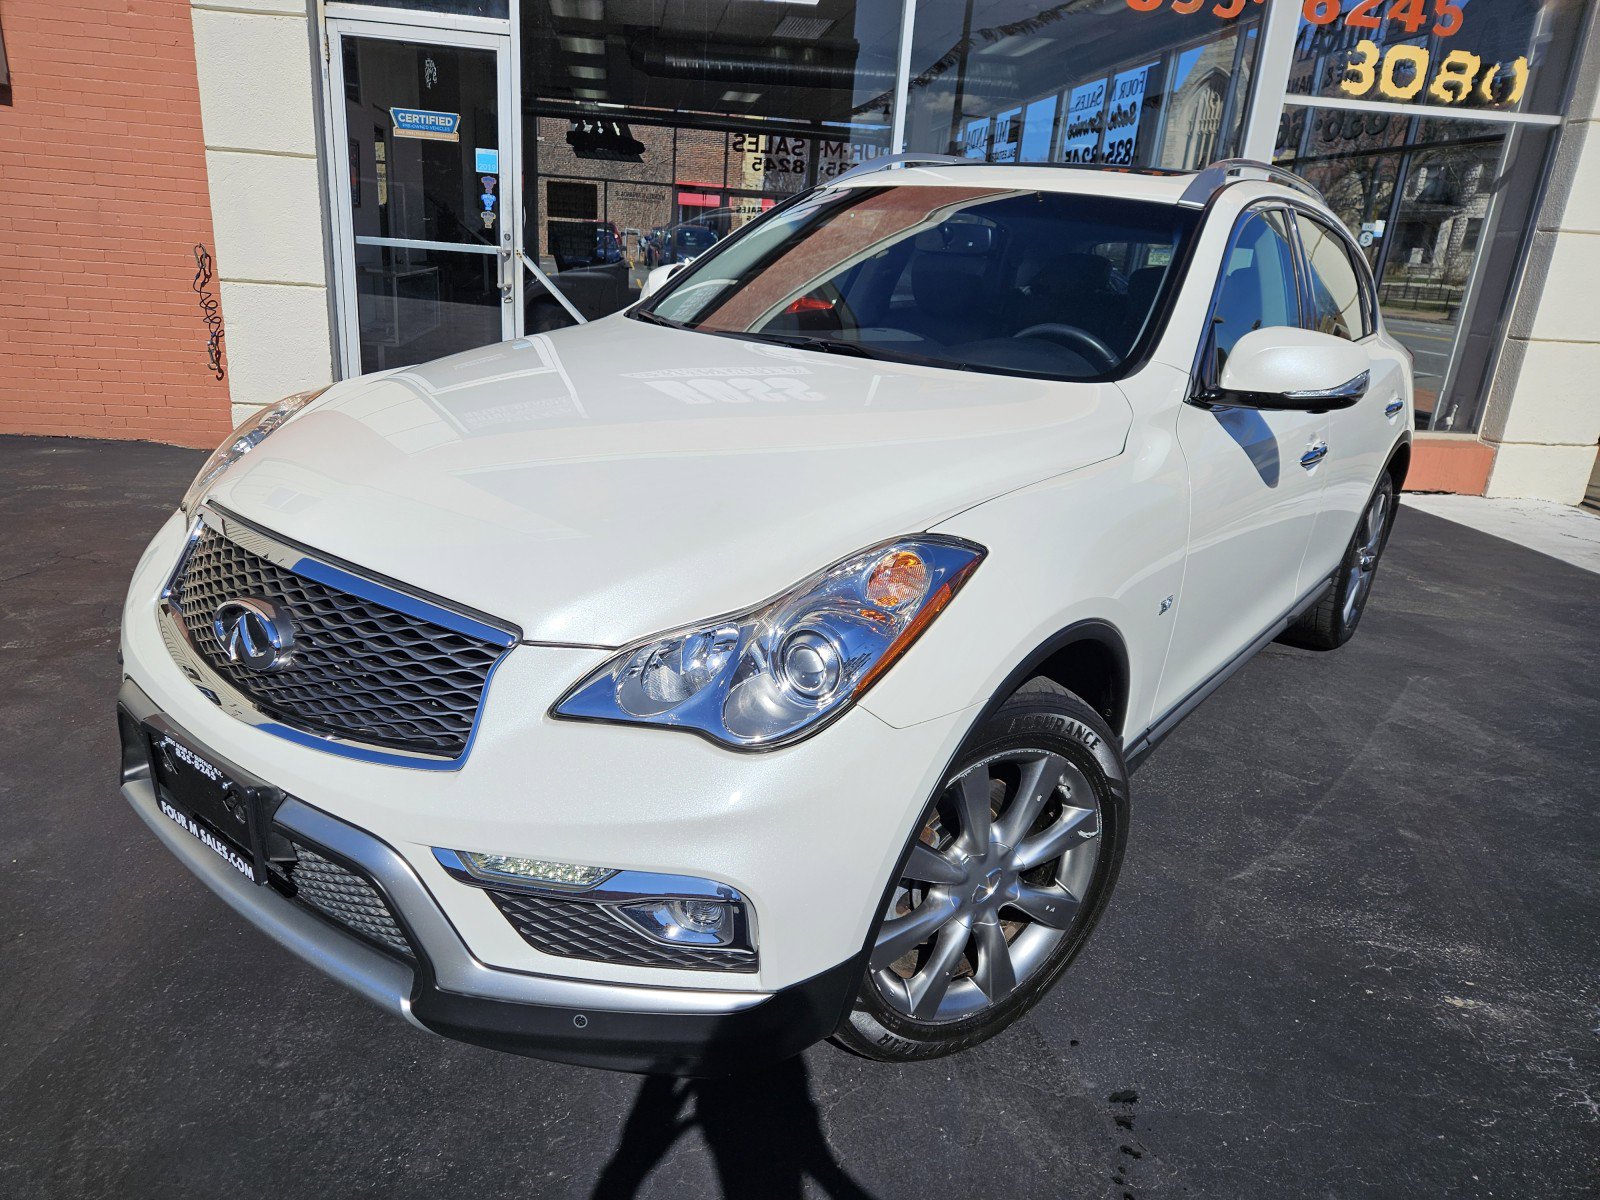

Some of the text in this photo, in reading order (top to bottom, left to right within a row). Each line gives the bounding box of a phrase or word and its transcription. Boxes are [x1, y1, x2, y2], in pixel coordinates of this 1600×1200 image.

[1340, 39, 1527, 104] 3080
[398, 113, 453, 126] CERTIFIED
[175, 747, 217, 781] 835-8245
[161, 800, 255, 882] FOUR M SALES.COM
